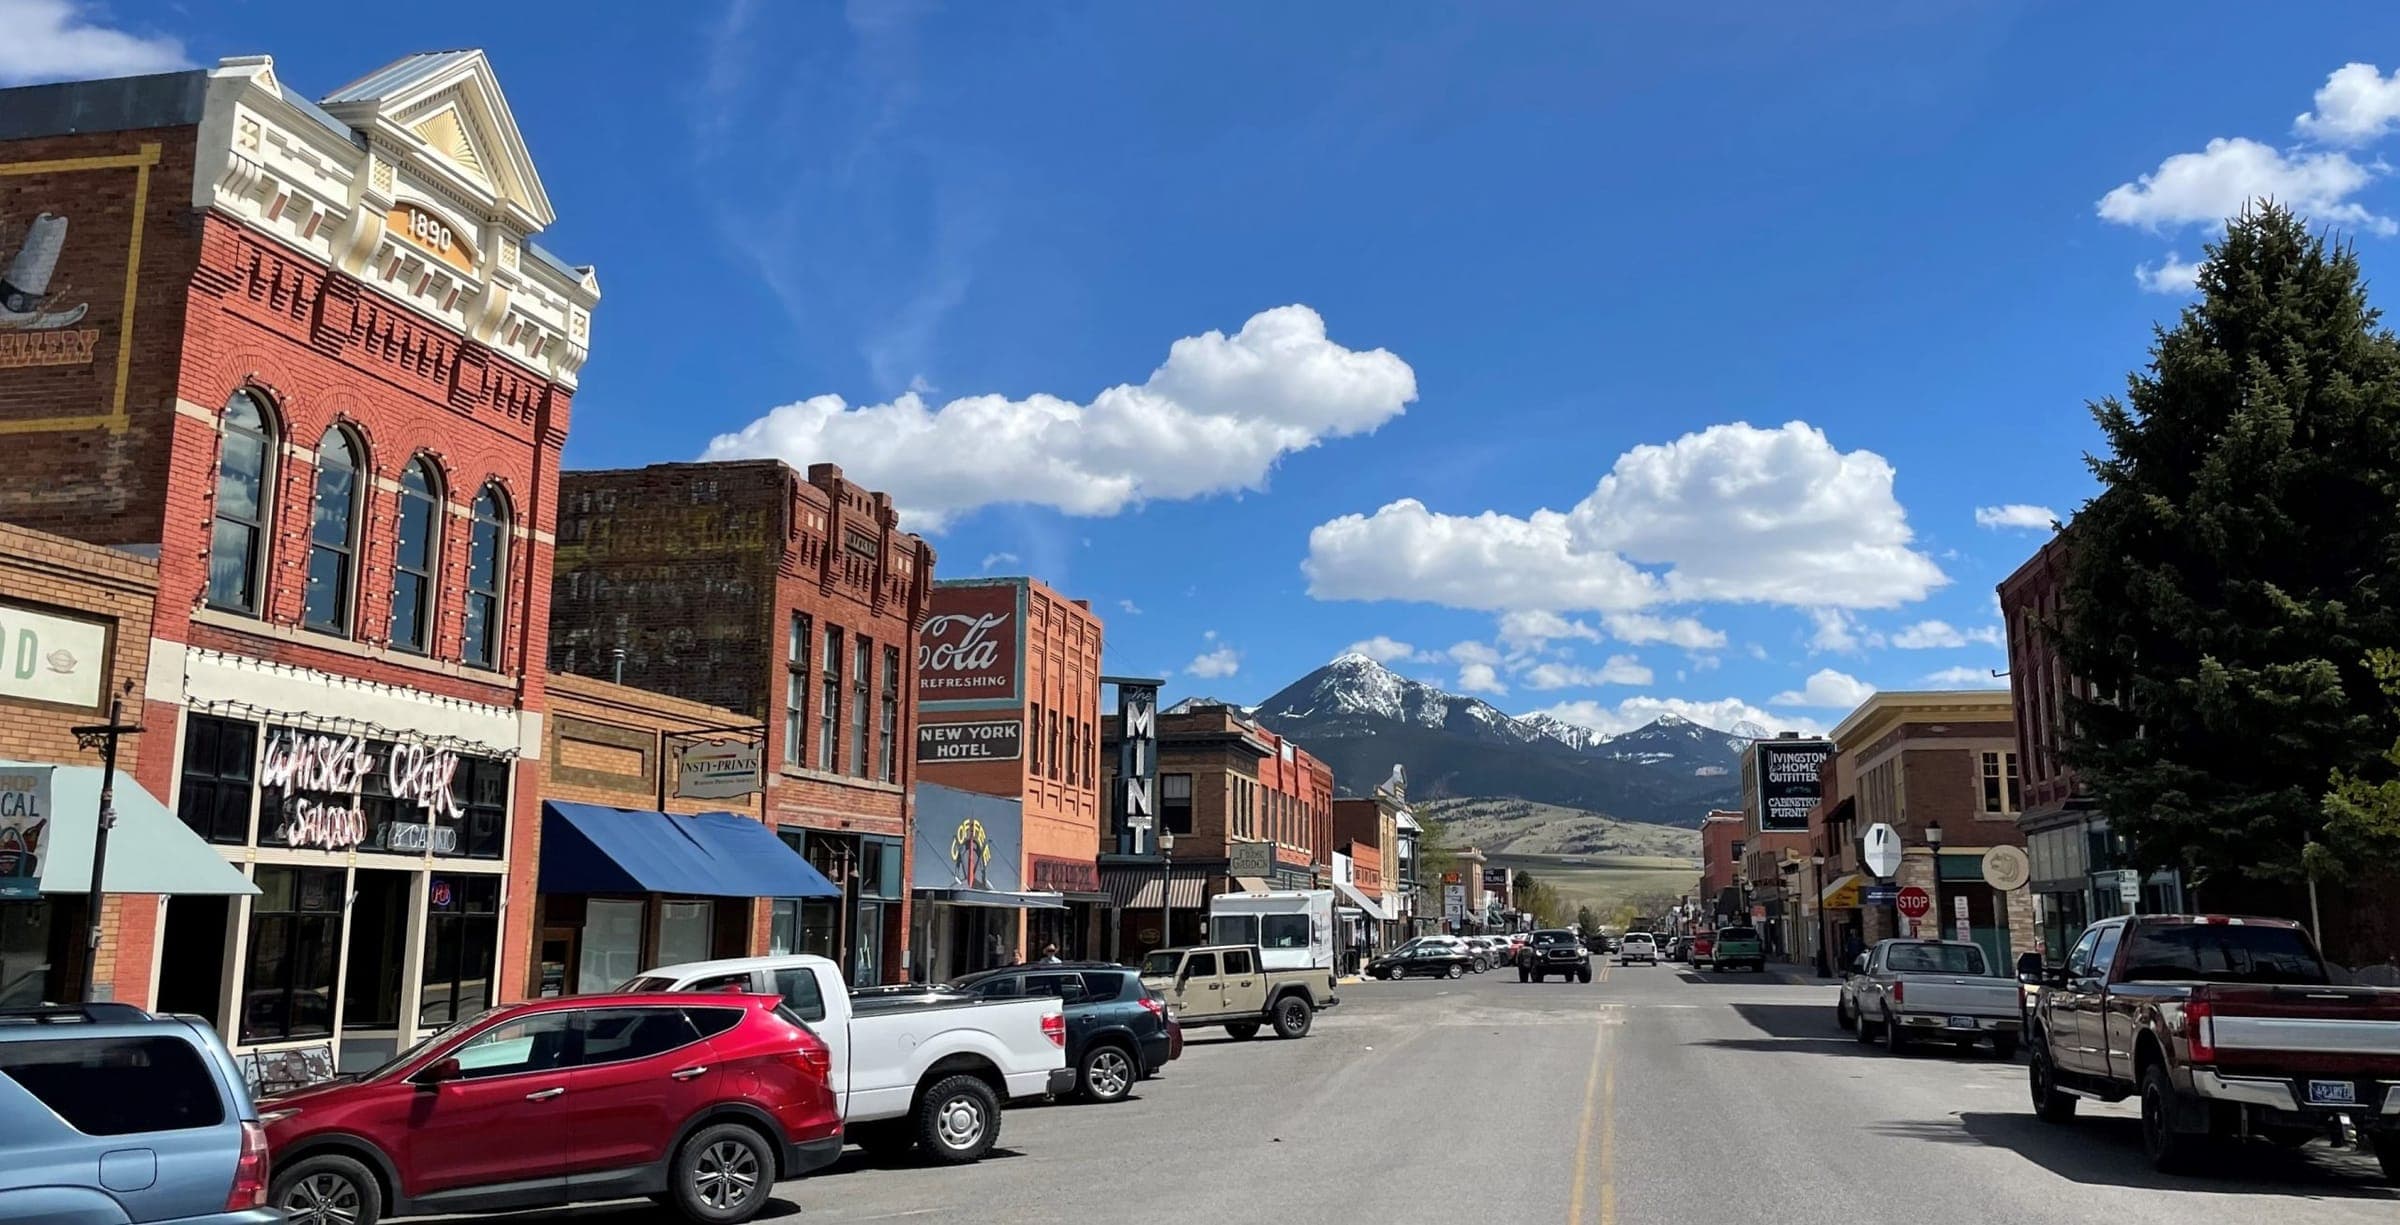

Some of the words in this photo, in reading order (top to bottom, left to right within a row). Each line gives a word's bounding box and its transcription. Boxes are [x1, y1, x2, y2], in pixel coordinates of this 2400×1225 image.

[409, 208, 452, 252] 1890
[920, 675, 1006, 688] REFRESHING
[920, 727, 962, 742] NEW
[968, 724, 1017, 739] YORK
[937, 743, 991, 757] HOTEL
[680, 759, 757, 774] INSTY-PRINTS
[1782, 763, 1817, 772] HOME
[1127, 701, 1155, 854] MINT
[1, 791, 40, 817] CAL
[409, 824, 457, 852] CAINO
[951, 818, 991, 867] COFFEE
[1899, 896, 1928, 908] STOP
